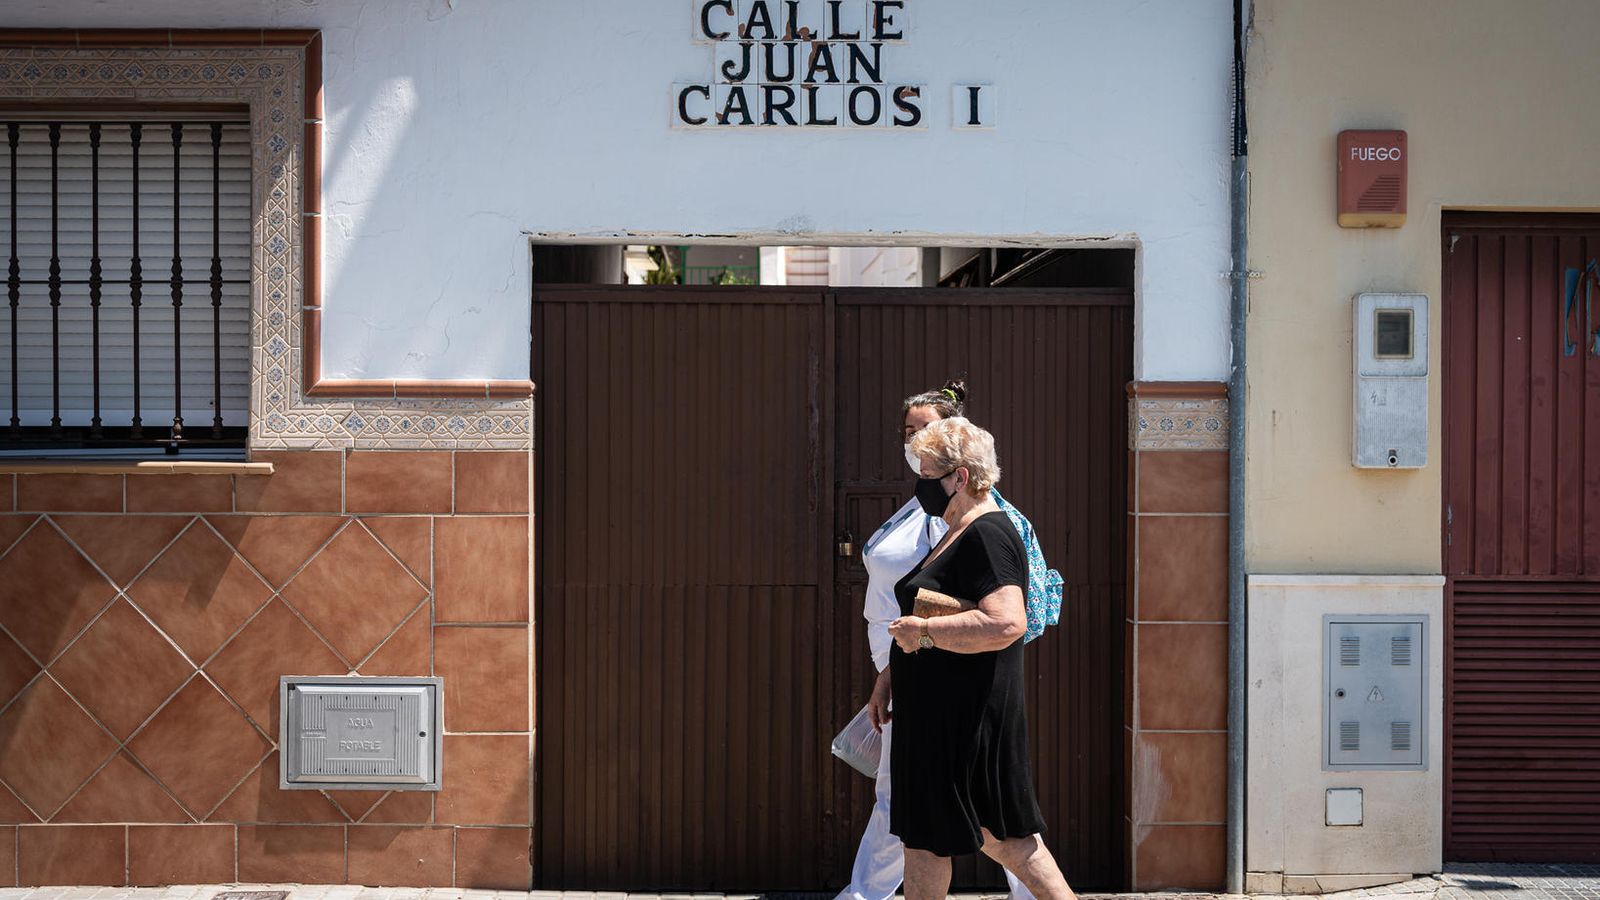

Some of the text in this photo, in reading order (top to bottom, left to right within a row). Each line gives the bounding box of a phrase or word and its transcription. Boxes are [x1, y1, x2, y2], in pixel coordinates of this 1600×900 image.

[700, 0, 903, 40] CALLE
[721, 42, 883, 84] JUAN
[678, 85, 981, 127] CARLOS I
[1351, 147, 1401, 161] FUEGO
[346, 717, 374, 729] AGUA
[339, 739, 382, 752] POTABLE
